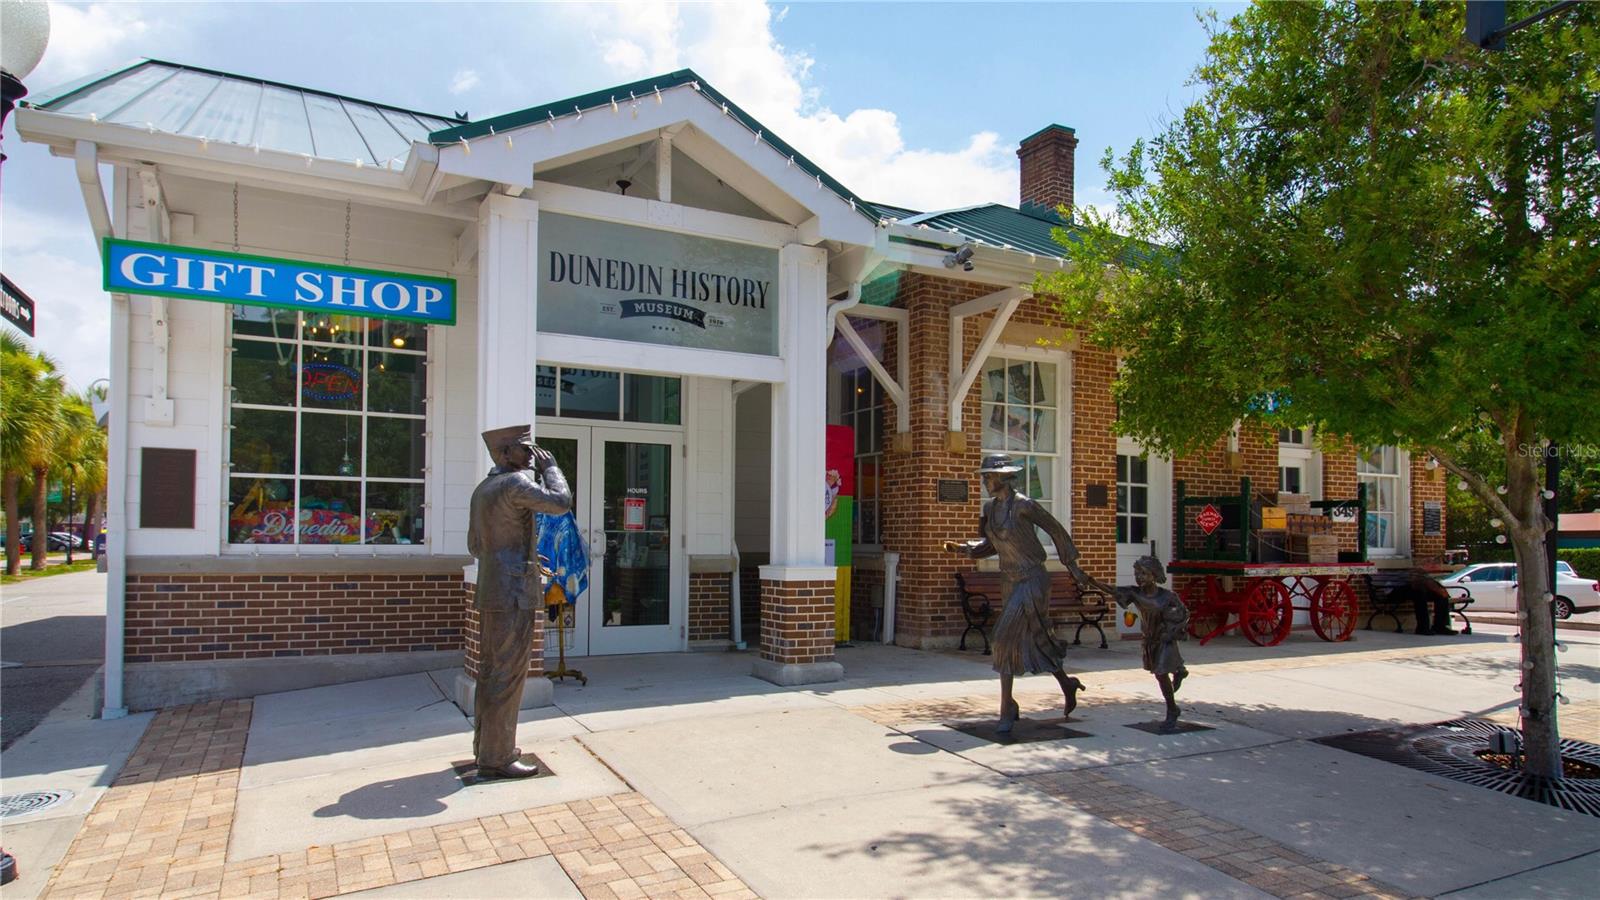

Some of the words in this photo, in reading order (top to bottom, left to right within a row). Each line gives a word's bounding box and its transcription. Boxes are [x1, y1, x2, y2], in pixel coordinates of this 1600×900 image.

[120, 253, 275, 297] GIFT
[295, 271, 443, 314] SHOP
[549, 250, 663, 296] DUNEDIN
[671, 268, 771, 309] HISTORY
[634, 303, 695, 319] MUSEUM
[251, 511, 349, 536] Dunedin
